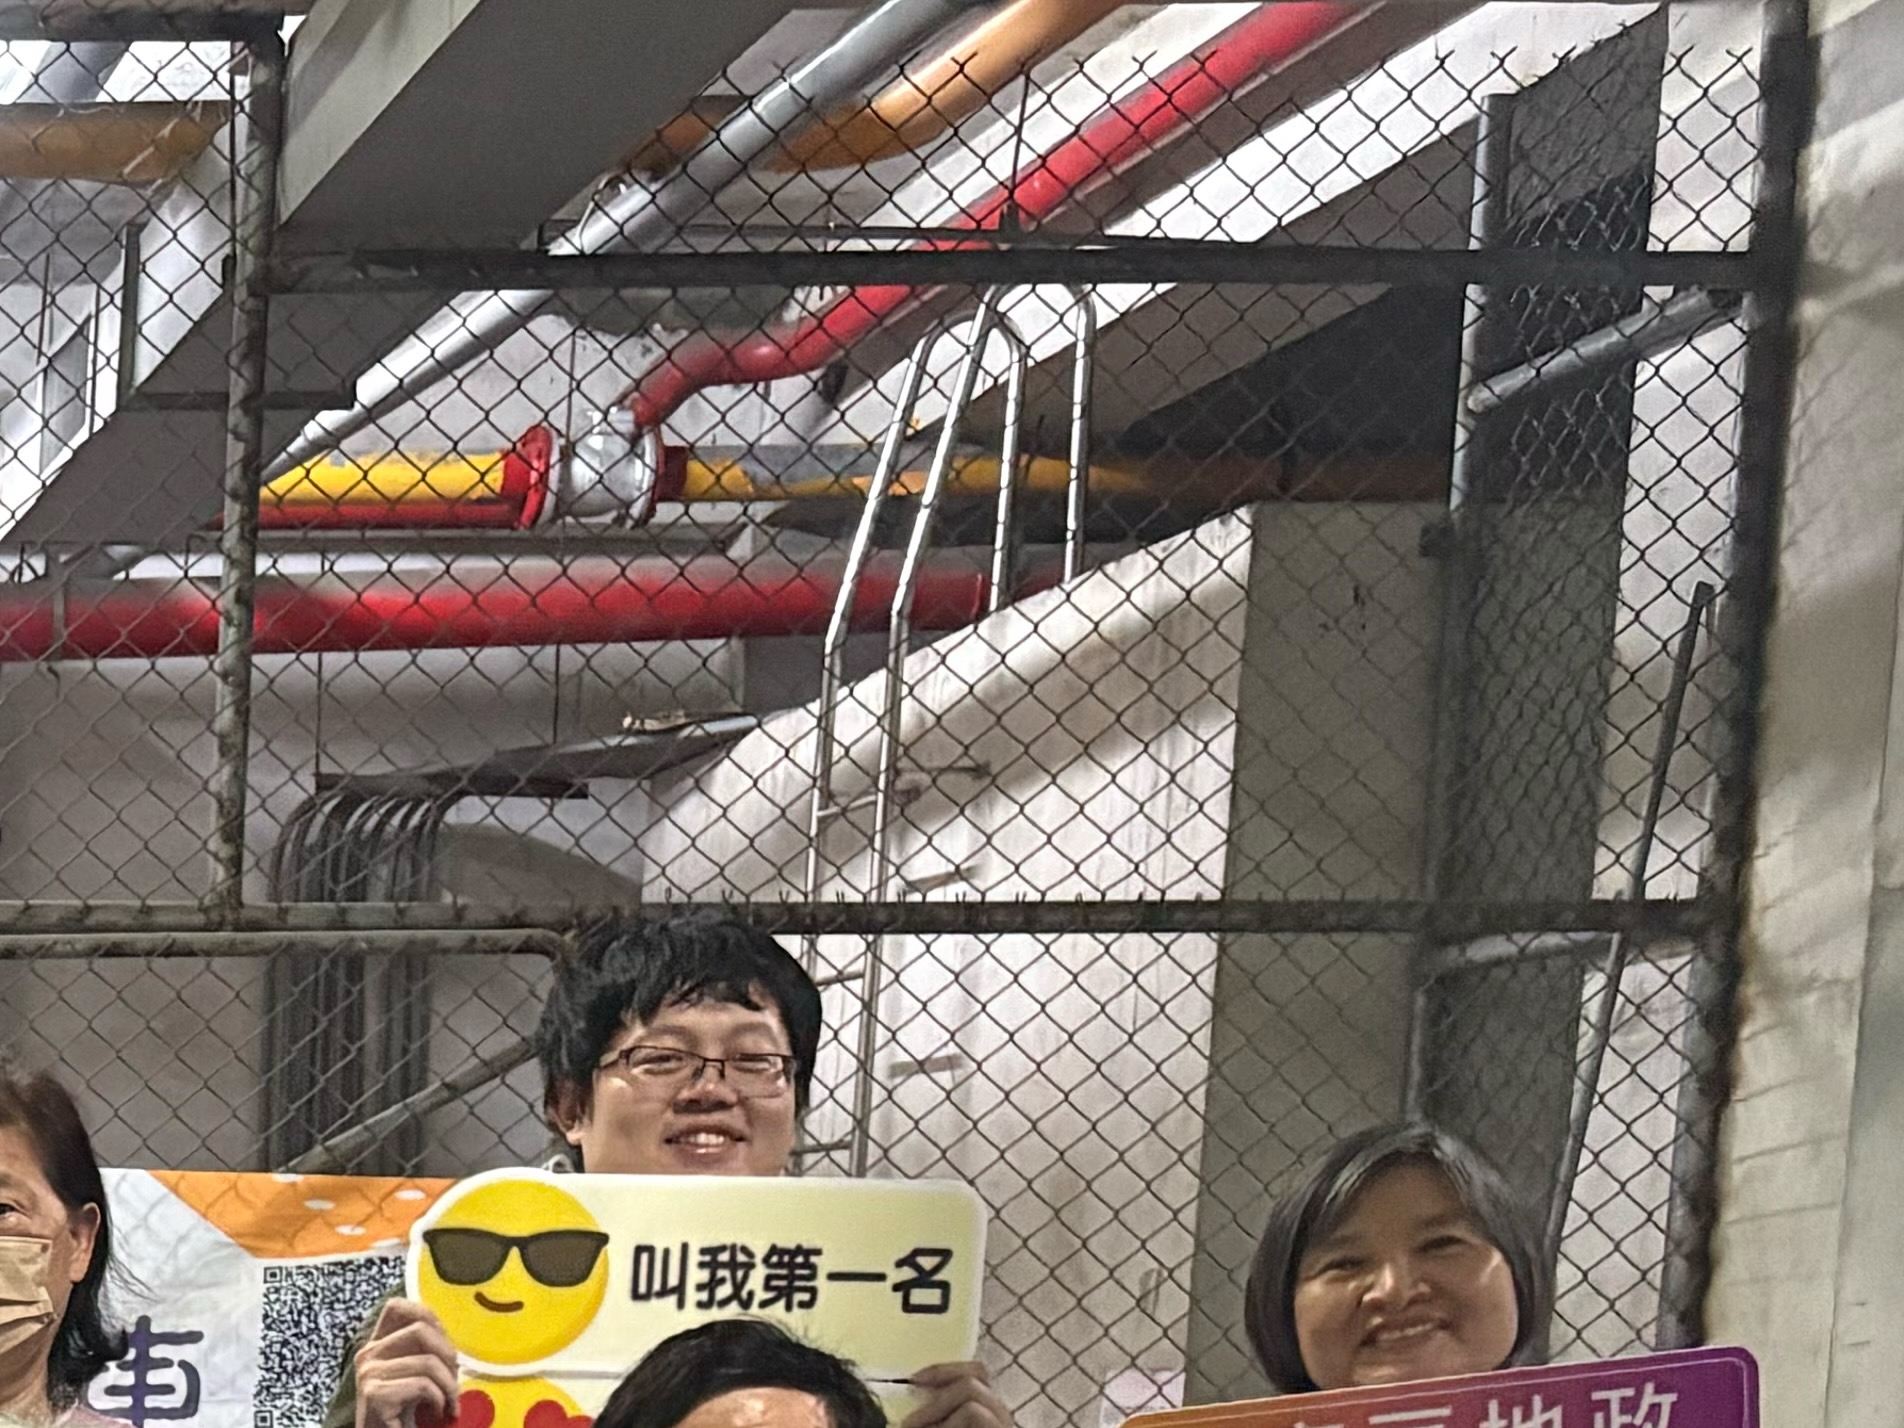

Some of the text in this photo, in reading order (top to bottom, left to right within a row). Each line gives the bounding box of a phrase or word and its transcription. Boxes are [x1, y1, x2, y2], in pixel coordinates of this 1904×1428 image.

[629, 1241, 954, 1316] 叫我第一名
